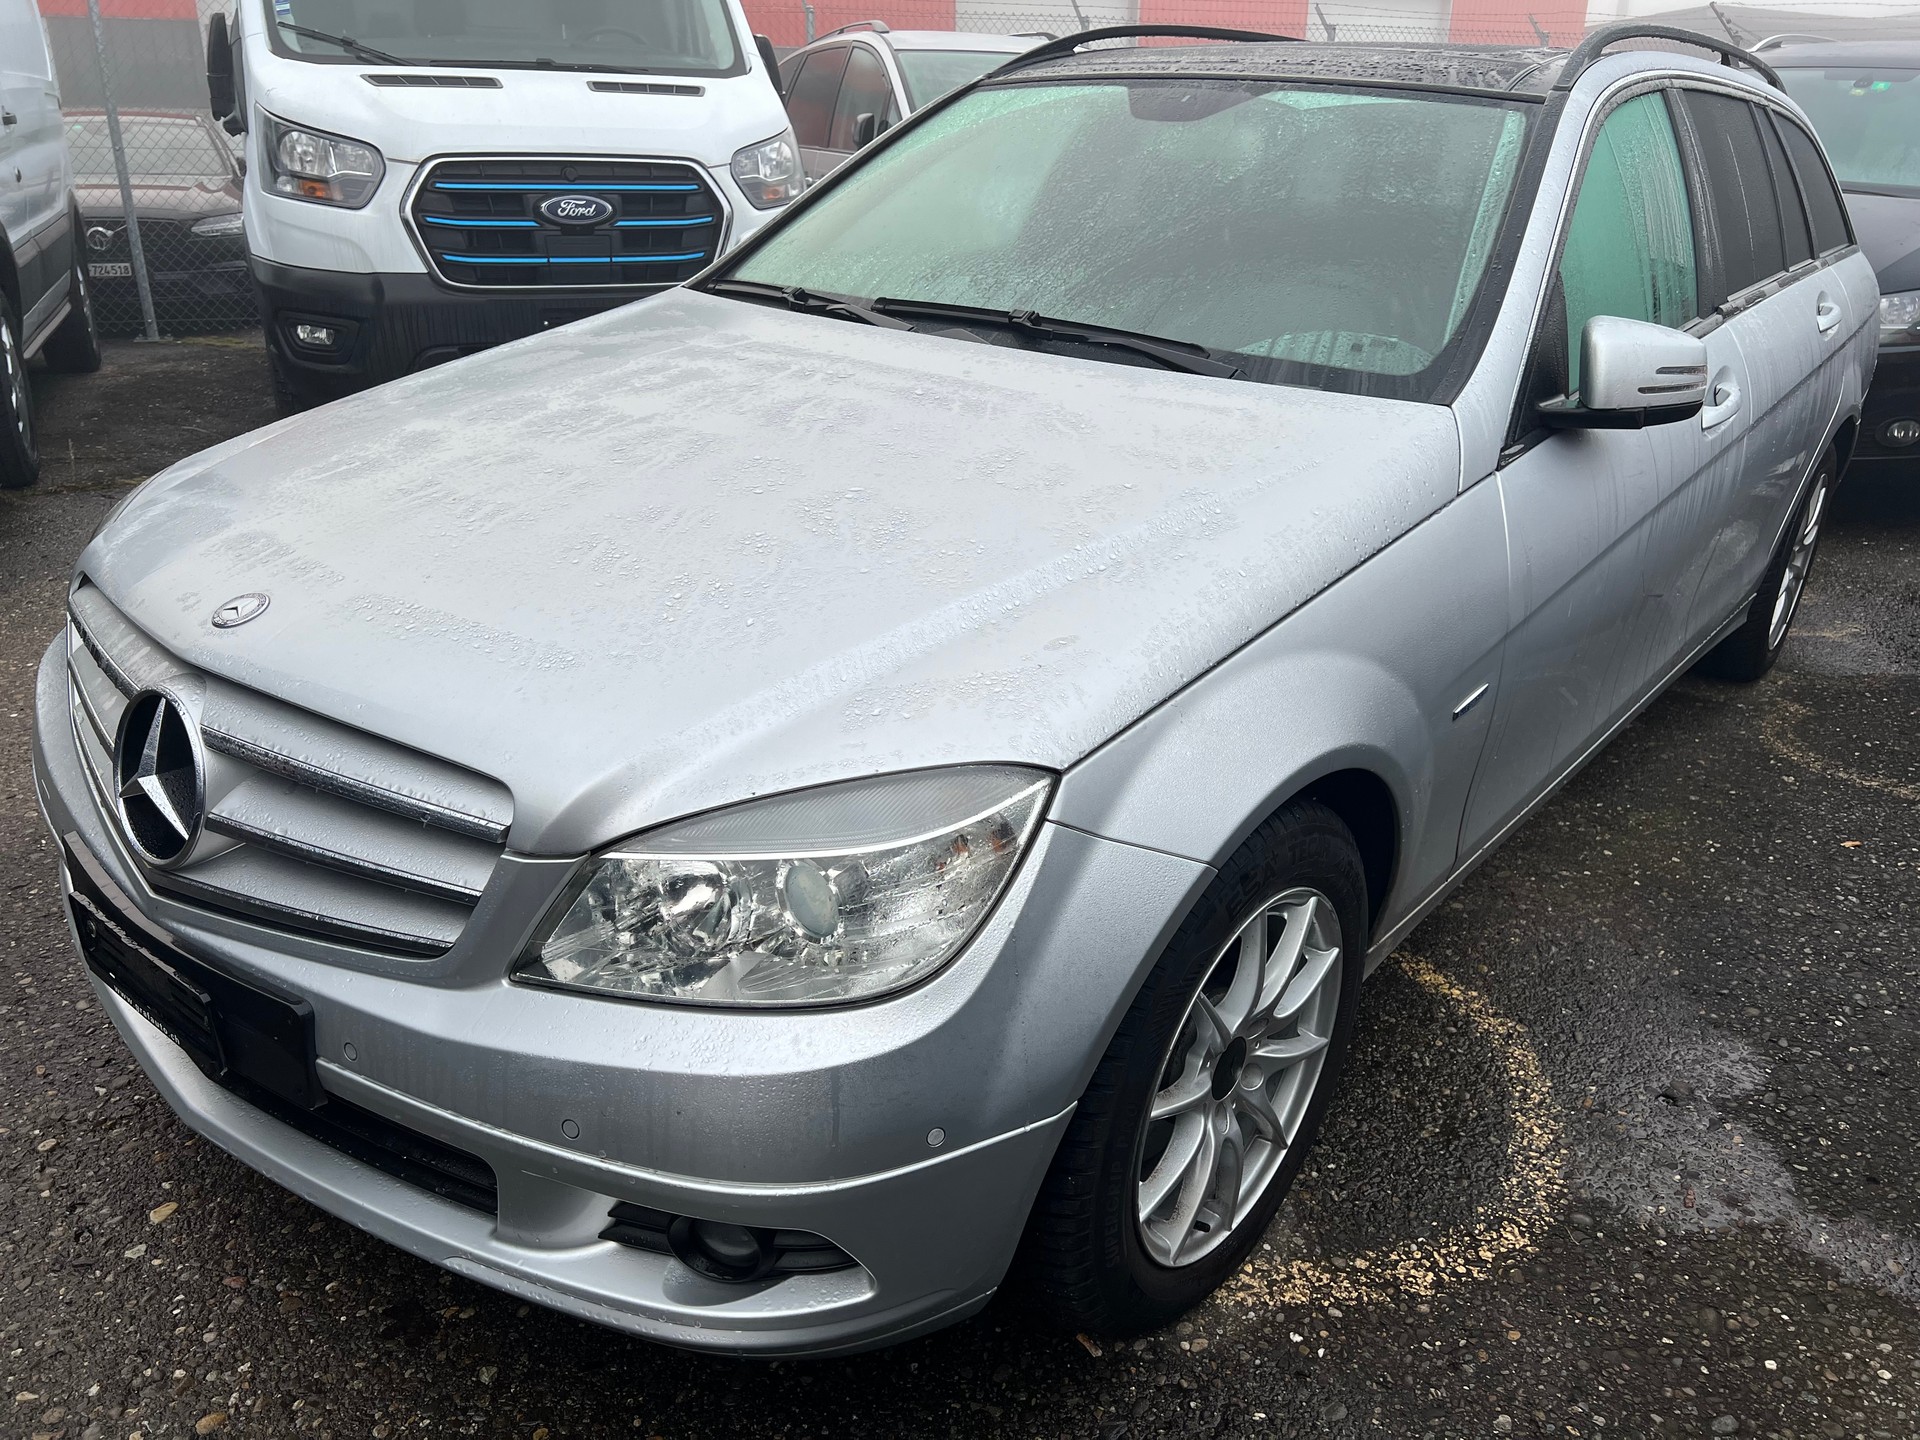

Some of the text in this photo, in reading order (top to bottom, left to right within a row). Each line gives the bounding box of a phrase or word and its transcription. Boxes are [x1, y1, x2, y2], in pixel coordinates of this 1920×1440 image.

[557, 199, 597, 217] Ford
[91, 265, 130, 275] 724518
[113, 985, 180, 1045] www.grafauto.ch
[1104, 1160, 1124, 1268] SUPERGRIP
